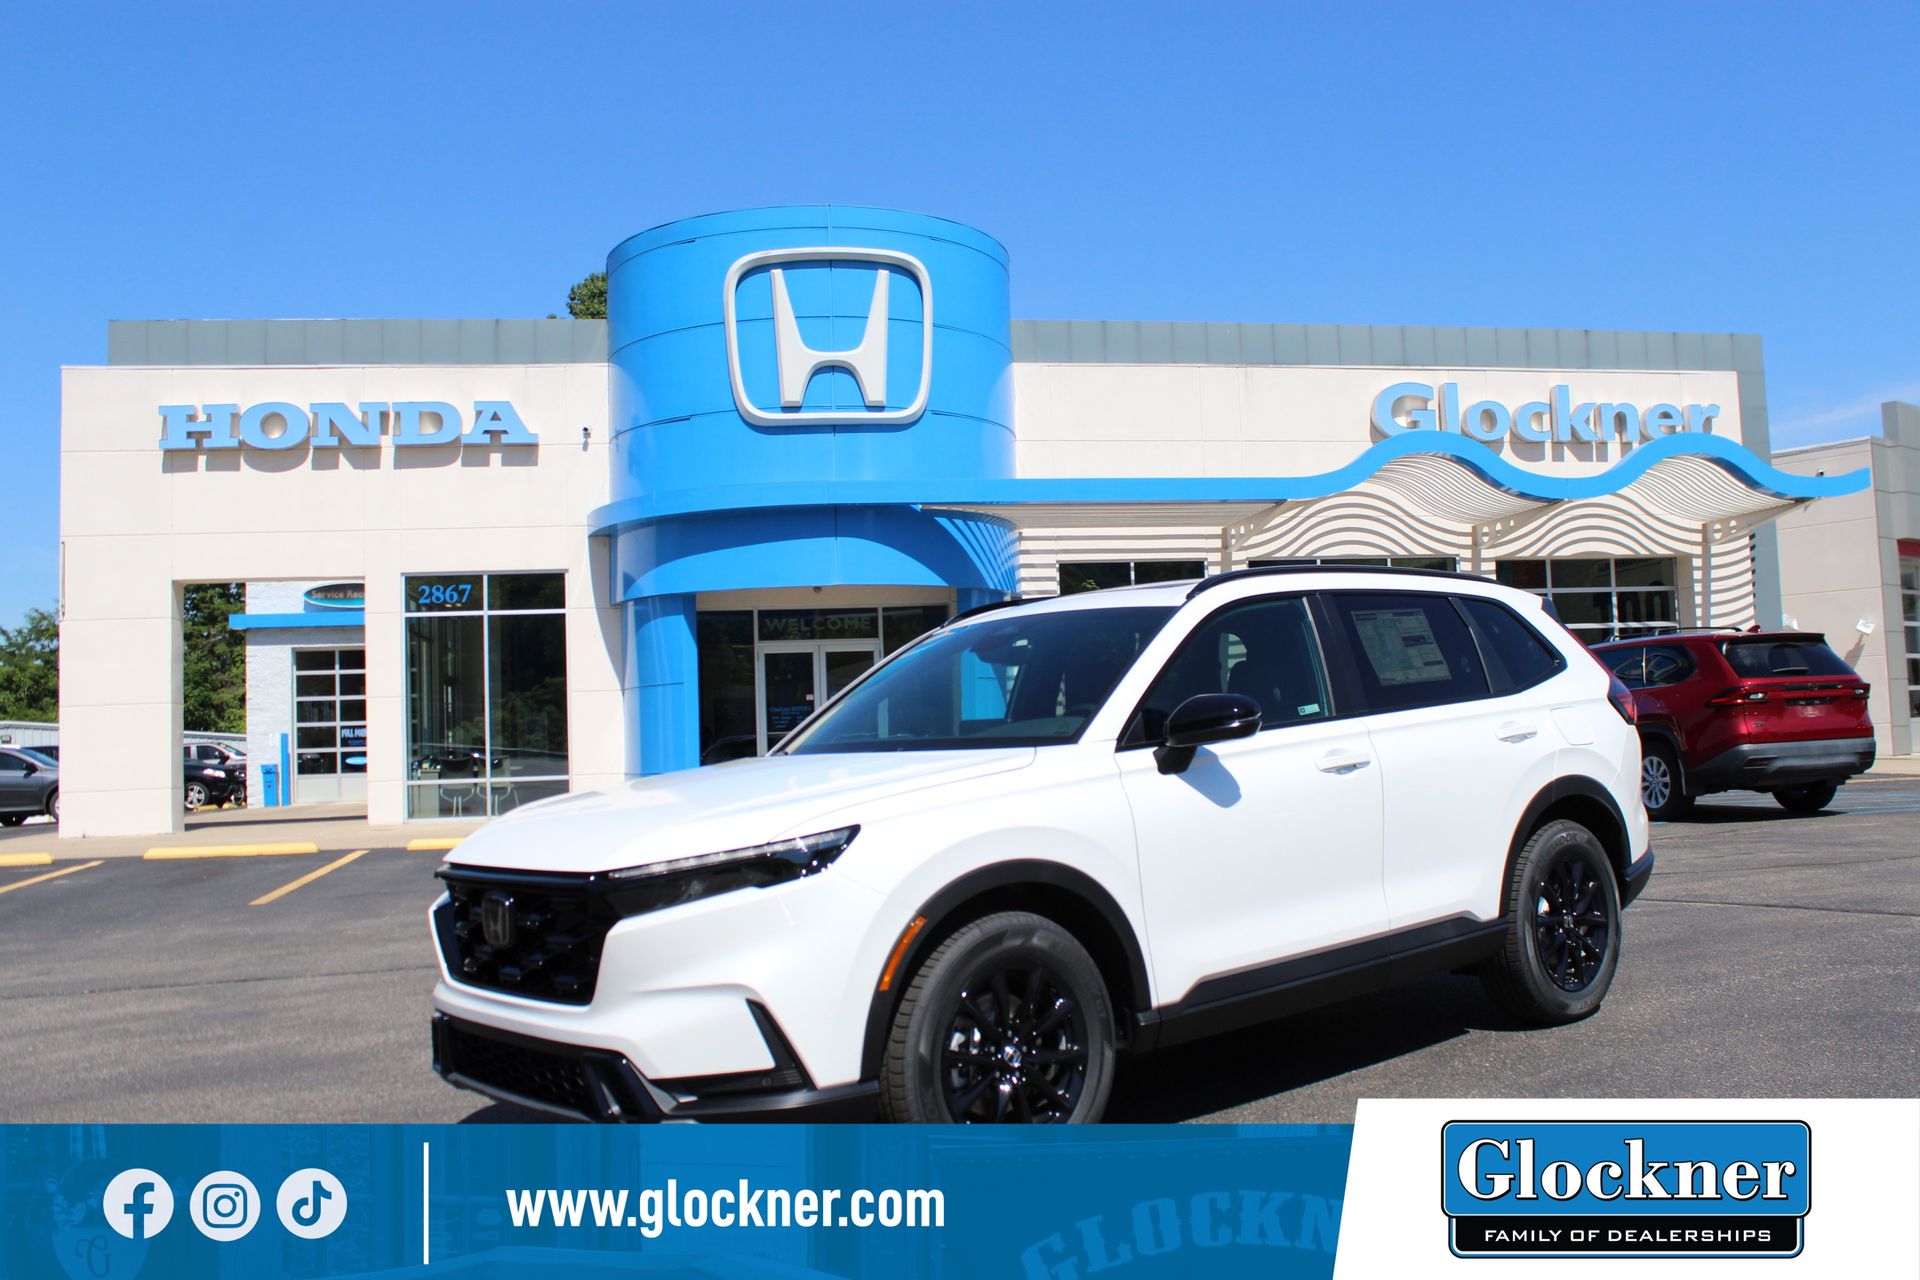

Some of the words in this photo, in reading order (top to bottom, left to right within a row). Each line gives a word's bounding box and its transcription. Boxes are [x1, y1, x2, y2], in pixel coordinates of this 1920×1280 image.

[158, 401, 539, 449] HONDA
[1371, 382, 1720, 442] Glockner
[417, 584, 472, 604] 2867
[765, 617, 872, 631] WELCOME
